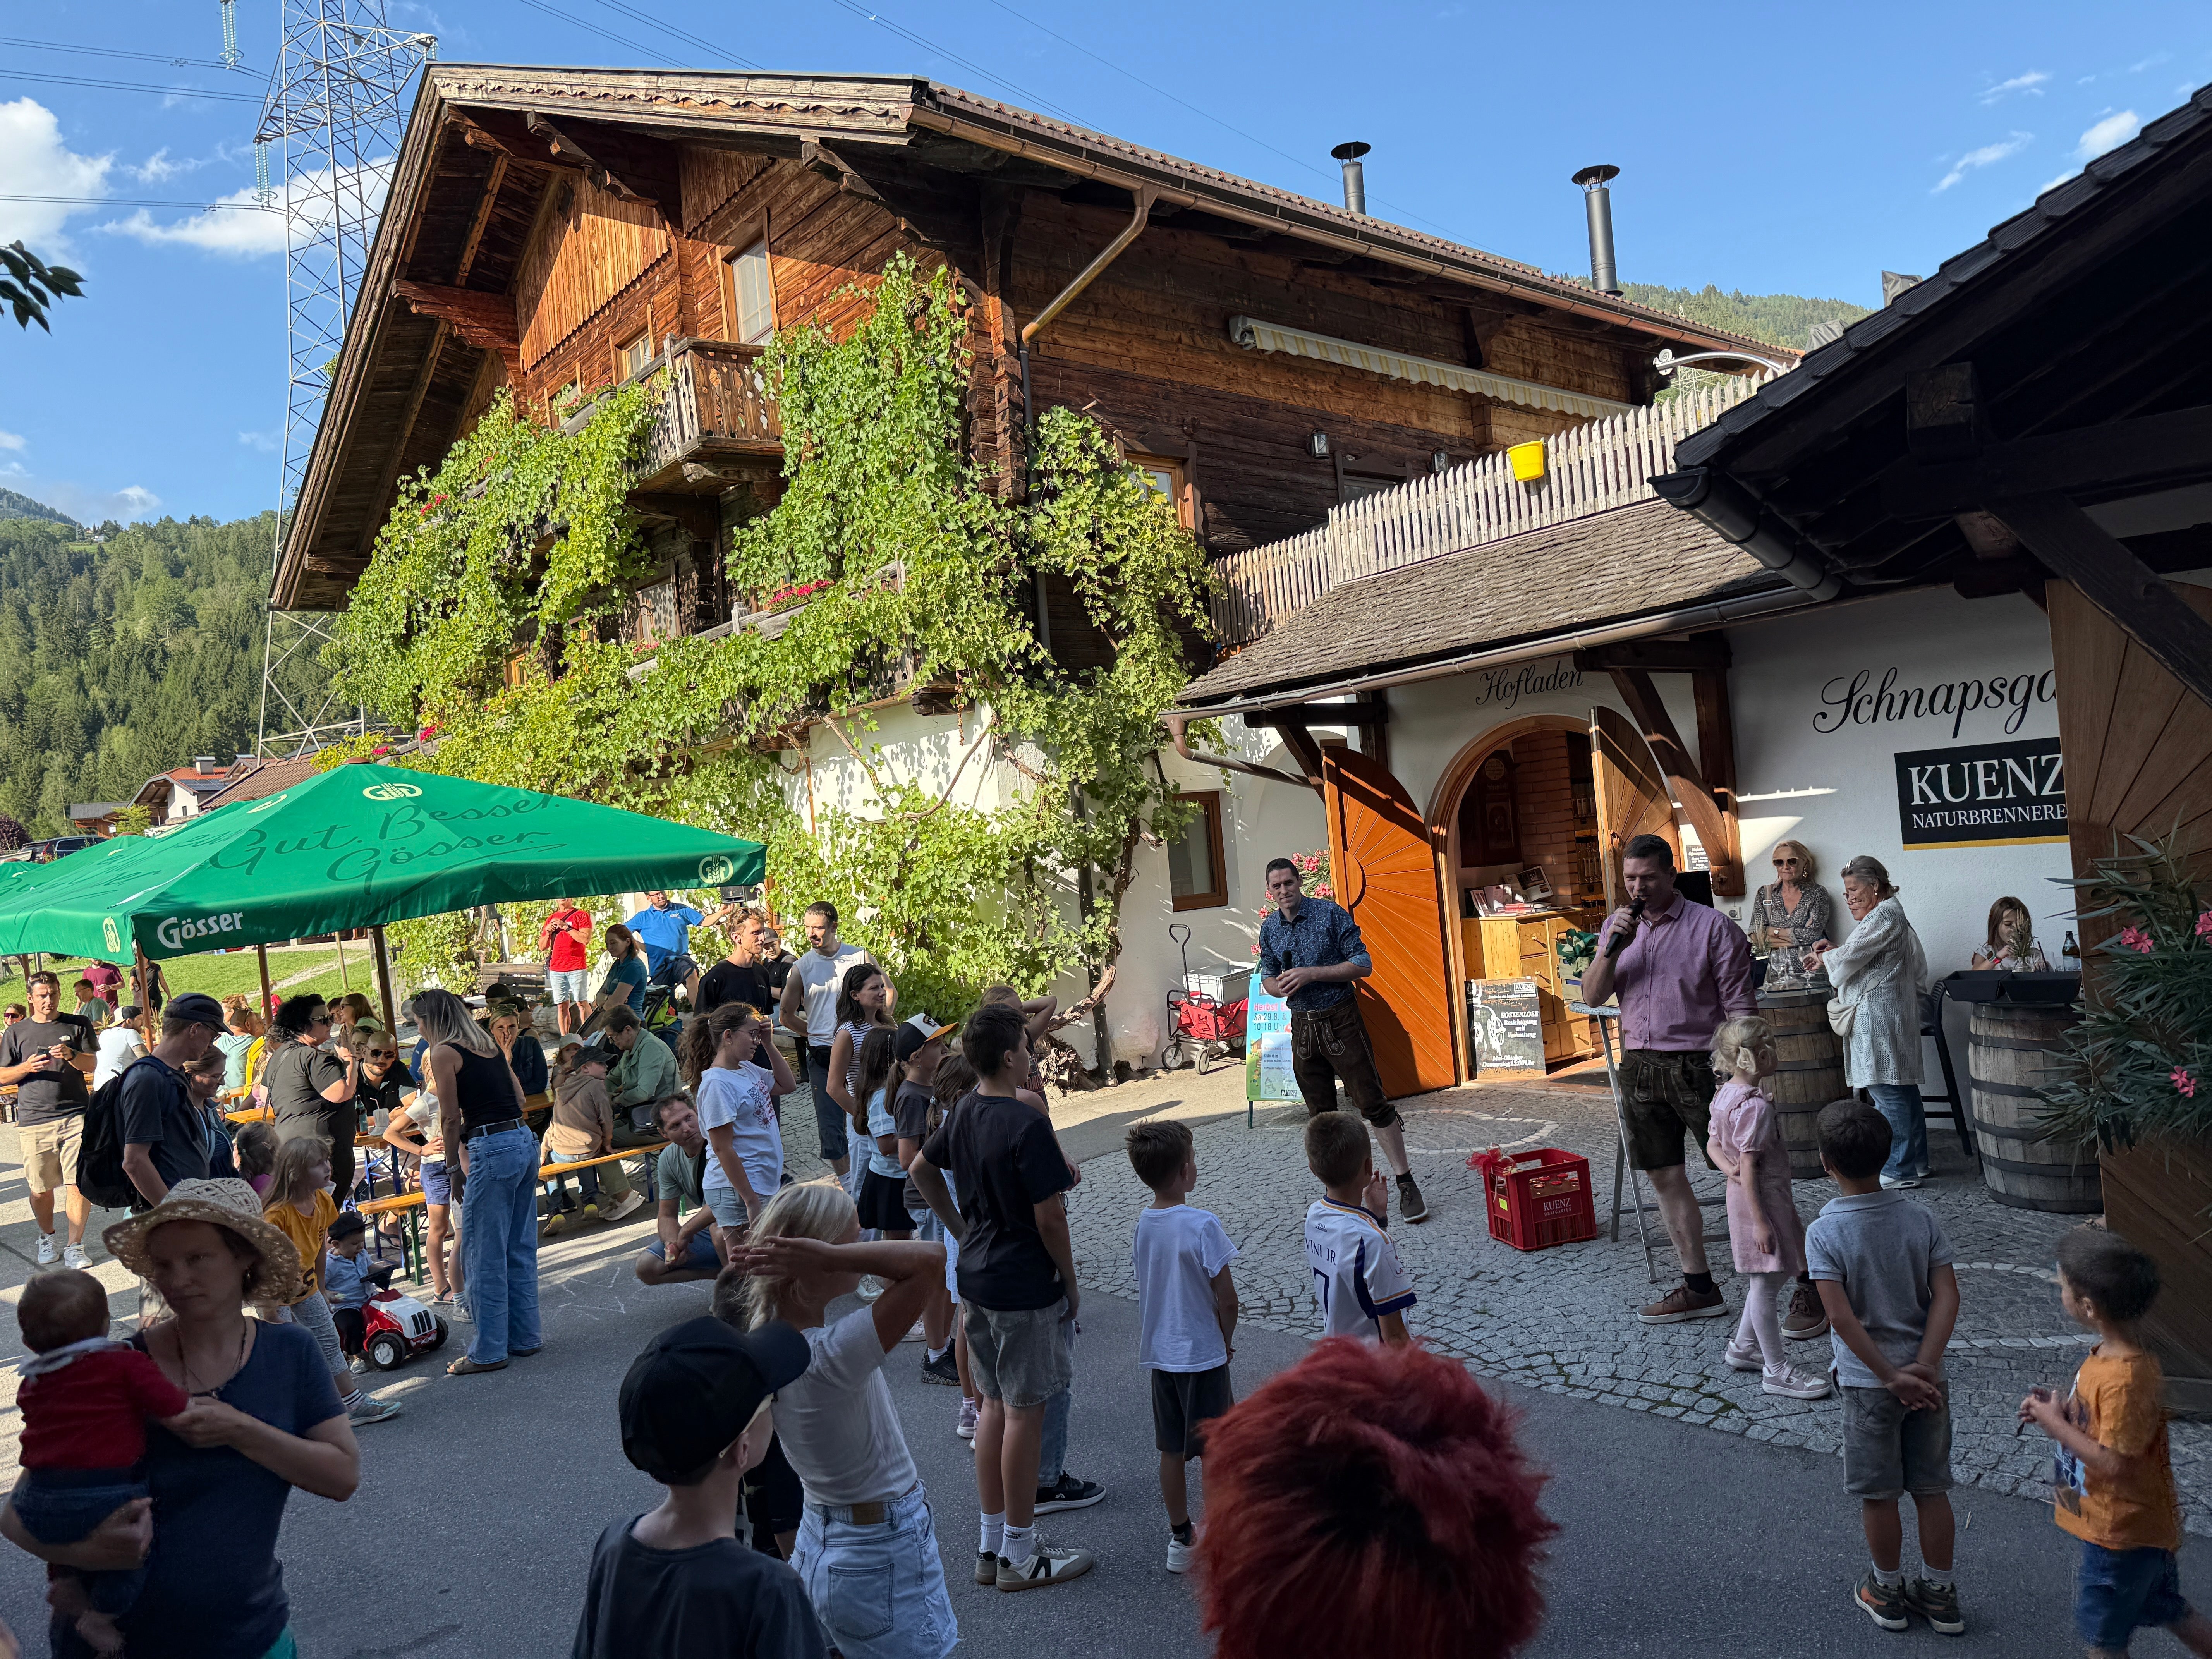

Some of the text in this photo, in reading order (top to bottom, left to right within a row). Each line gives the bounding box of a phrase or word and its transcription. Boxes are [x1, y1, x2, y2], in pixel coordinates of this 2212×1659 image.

[1476, 660, 1583, 709] Hofladen
[1908, 754, 2065, 805] KUENZ
[157, 912, 243, 949] Gösser
[1544, 1198, 1571, 1211] KUENZ
[1305, 1238, 1336, 1265] VINI JR
[1313, 1267, 1329, 1327] 7
